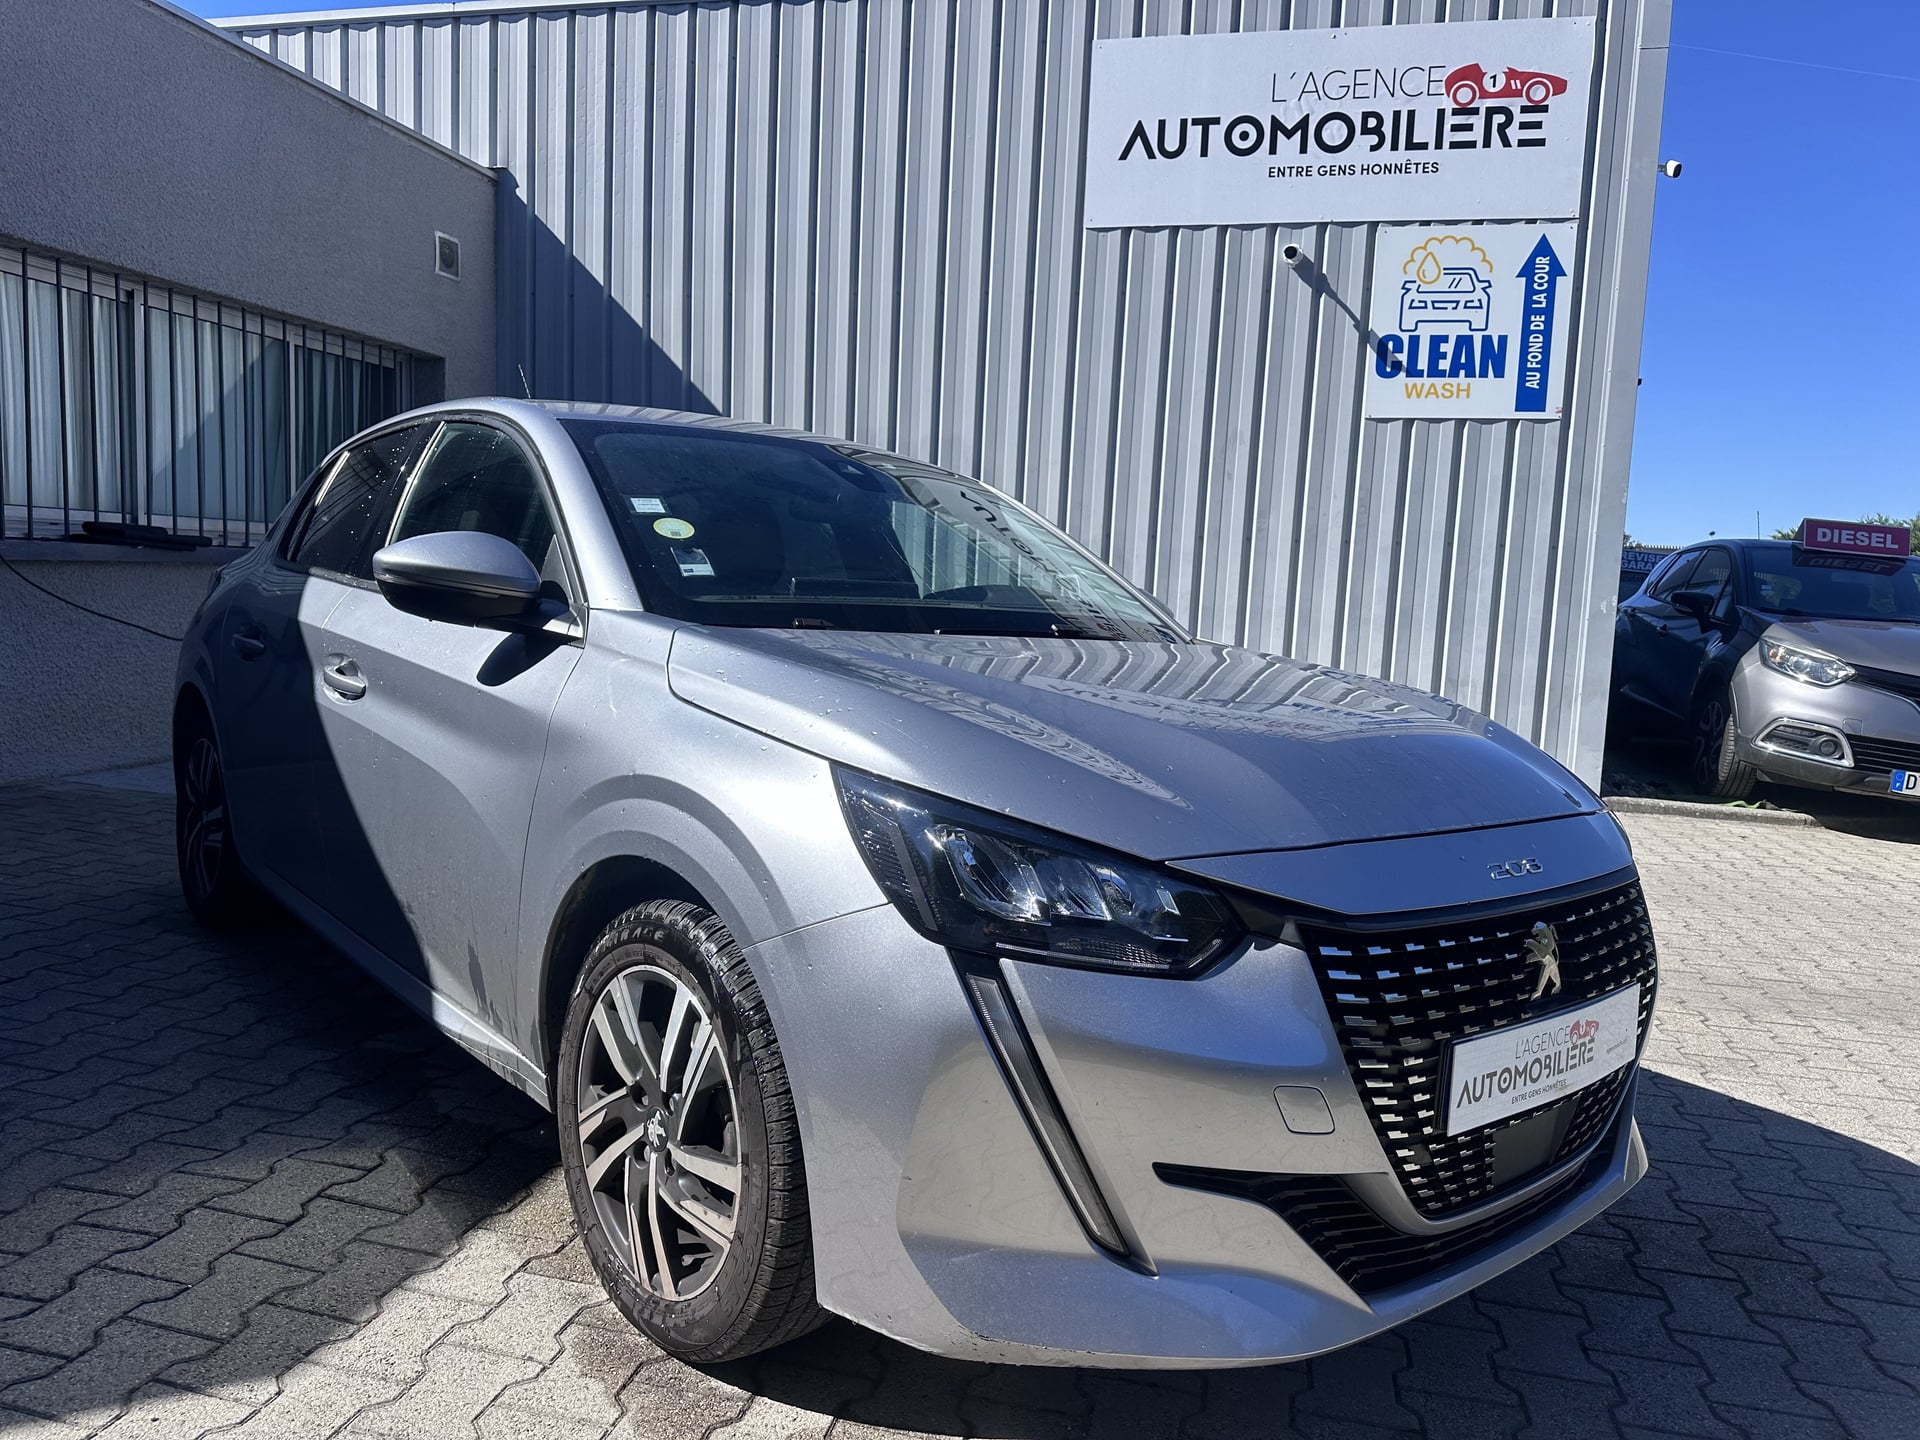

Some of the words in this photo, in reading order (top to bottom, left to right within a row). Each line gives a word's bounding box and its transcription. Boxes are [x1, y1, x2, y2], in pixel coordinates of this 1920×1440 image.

[1489, 73, 1497, 89] 1
[1268, 165, 1313, 178] ENTRE
[1317, 164, 1356, 177] GENS
[1360, 159, 1440, 176] HONNÊTES
[1532, 255, 1551, 290] COUR
[1531, 293, 1548, 308] LA
[1530, 314, 1545, 331] DE
[1375, 333, 1508, 379] CLEAN
[1527, 334, 1544, 368] FOND
[1525, 371, 1540, 389] AU
[1404, 382, 1471, 399] WASH
[1816, 527, 1899, 549] DIESEL
[1621, 560, 1656, 571] GARA
[1905, 773, 1920, 790] D
[1511, 1092, 1528, 1105] ENTRE
[1527, 1087, 1542, 1099] GENS
